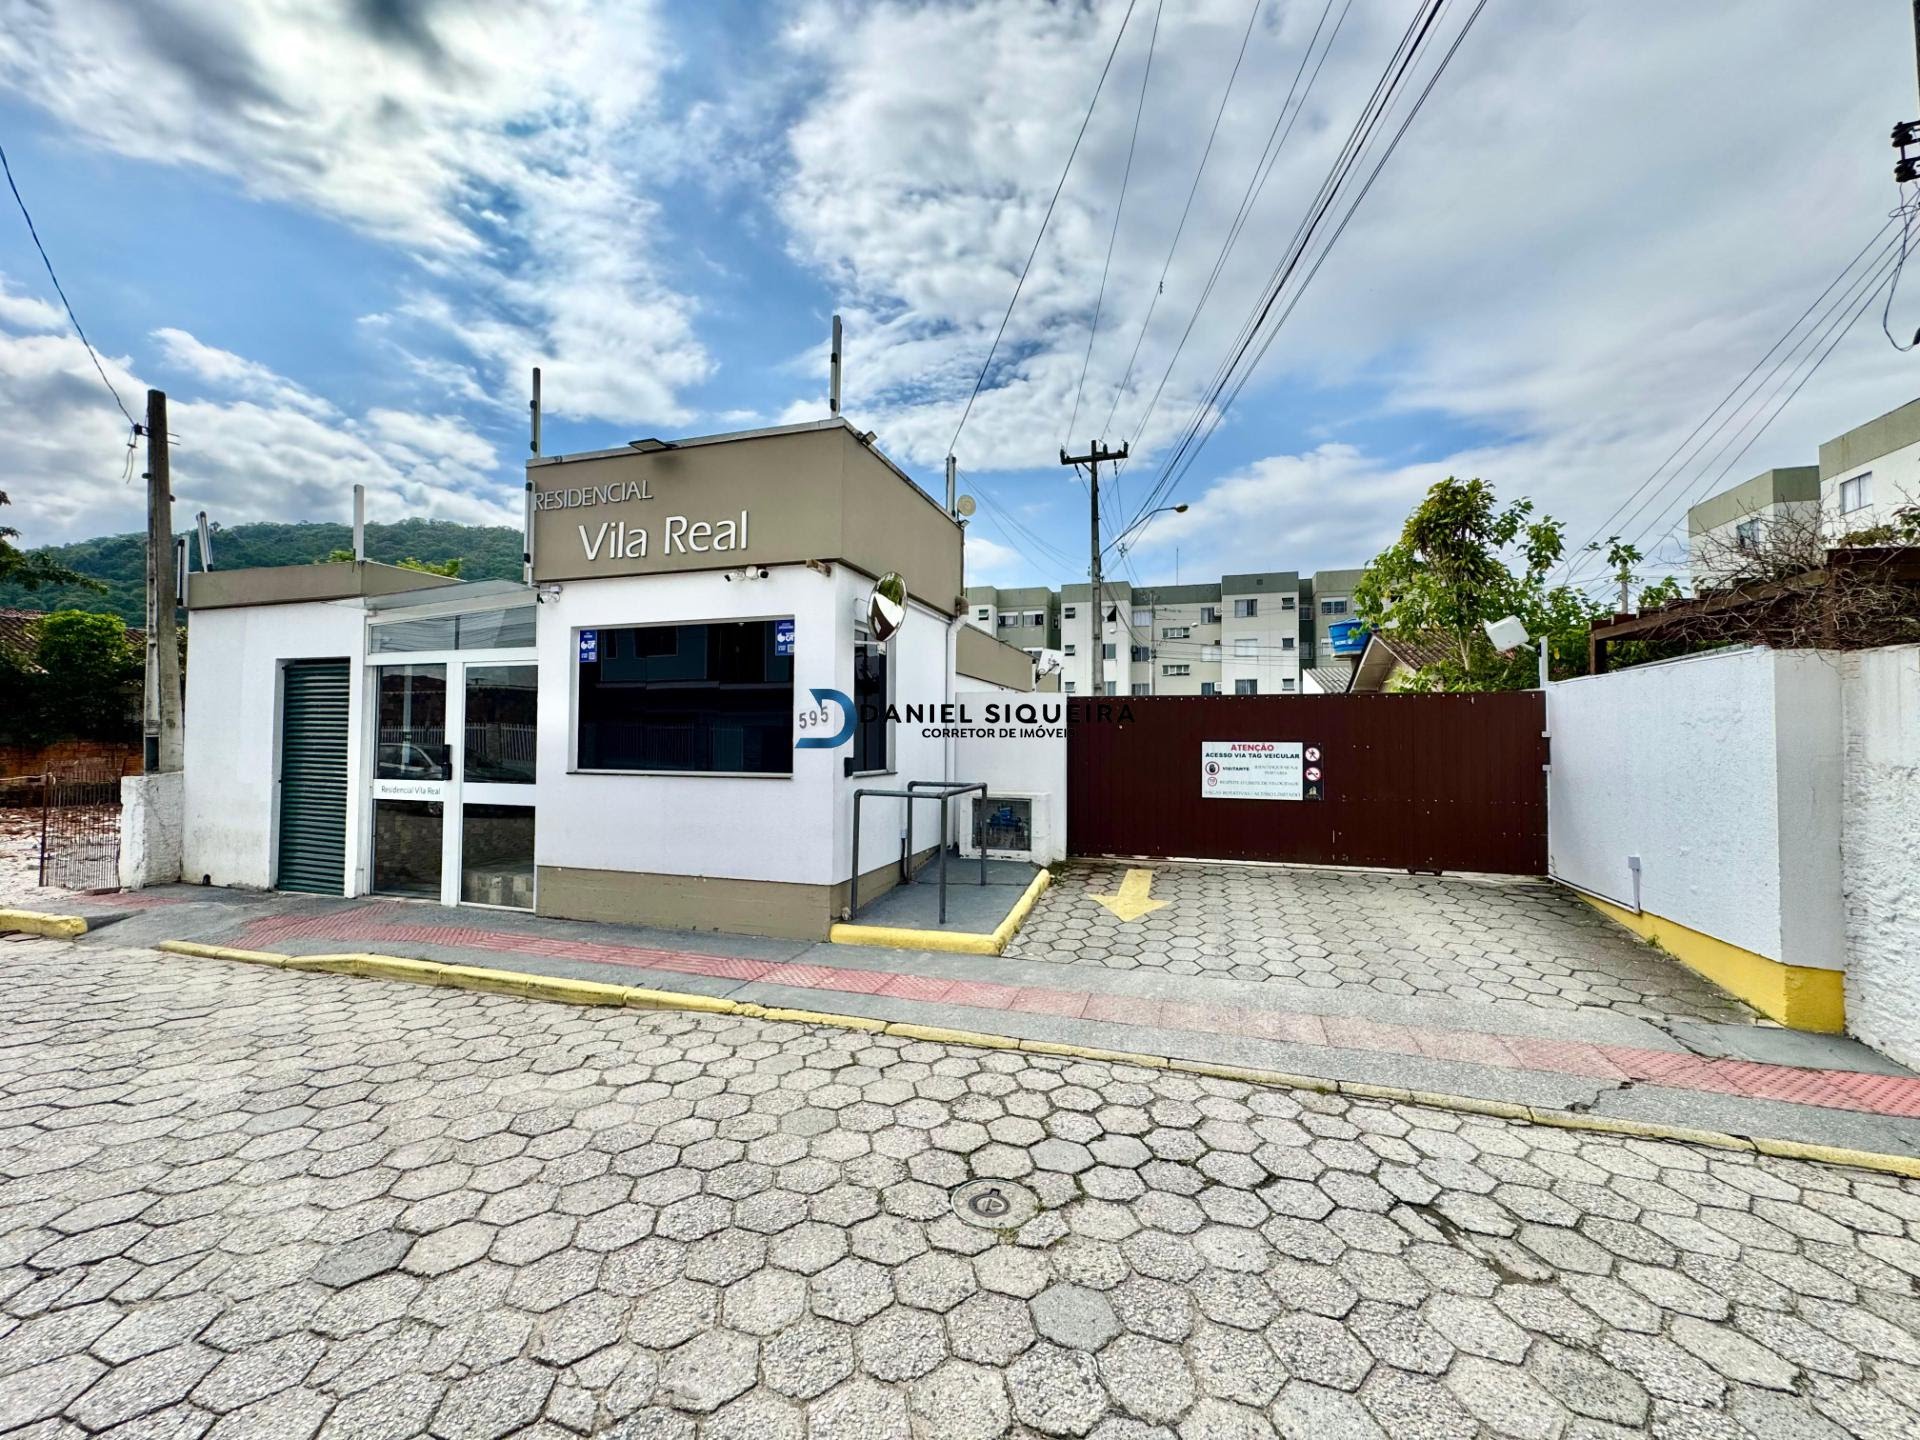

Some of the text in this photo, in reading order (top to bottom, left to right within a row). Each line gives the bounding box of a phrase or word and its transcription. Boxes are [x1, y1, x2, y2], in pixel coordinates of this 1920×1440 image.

[534, 480, 654, 511] RESIDENCIAL
[578, 510, 748, 561] Vila Real
[799, 706, 829, 729] 595
[1231, 743, 1275, 753] ATENÇÃO
[1264, 752, 1300, 760] VEICULAR
